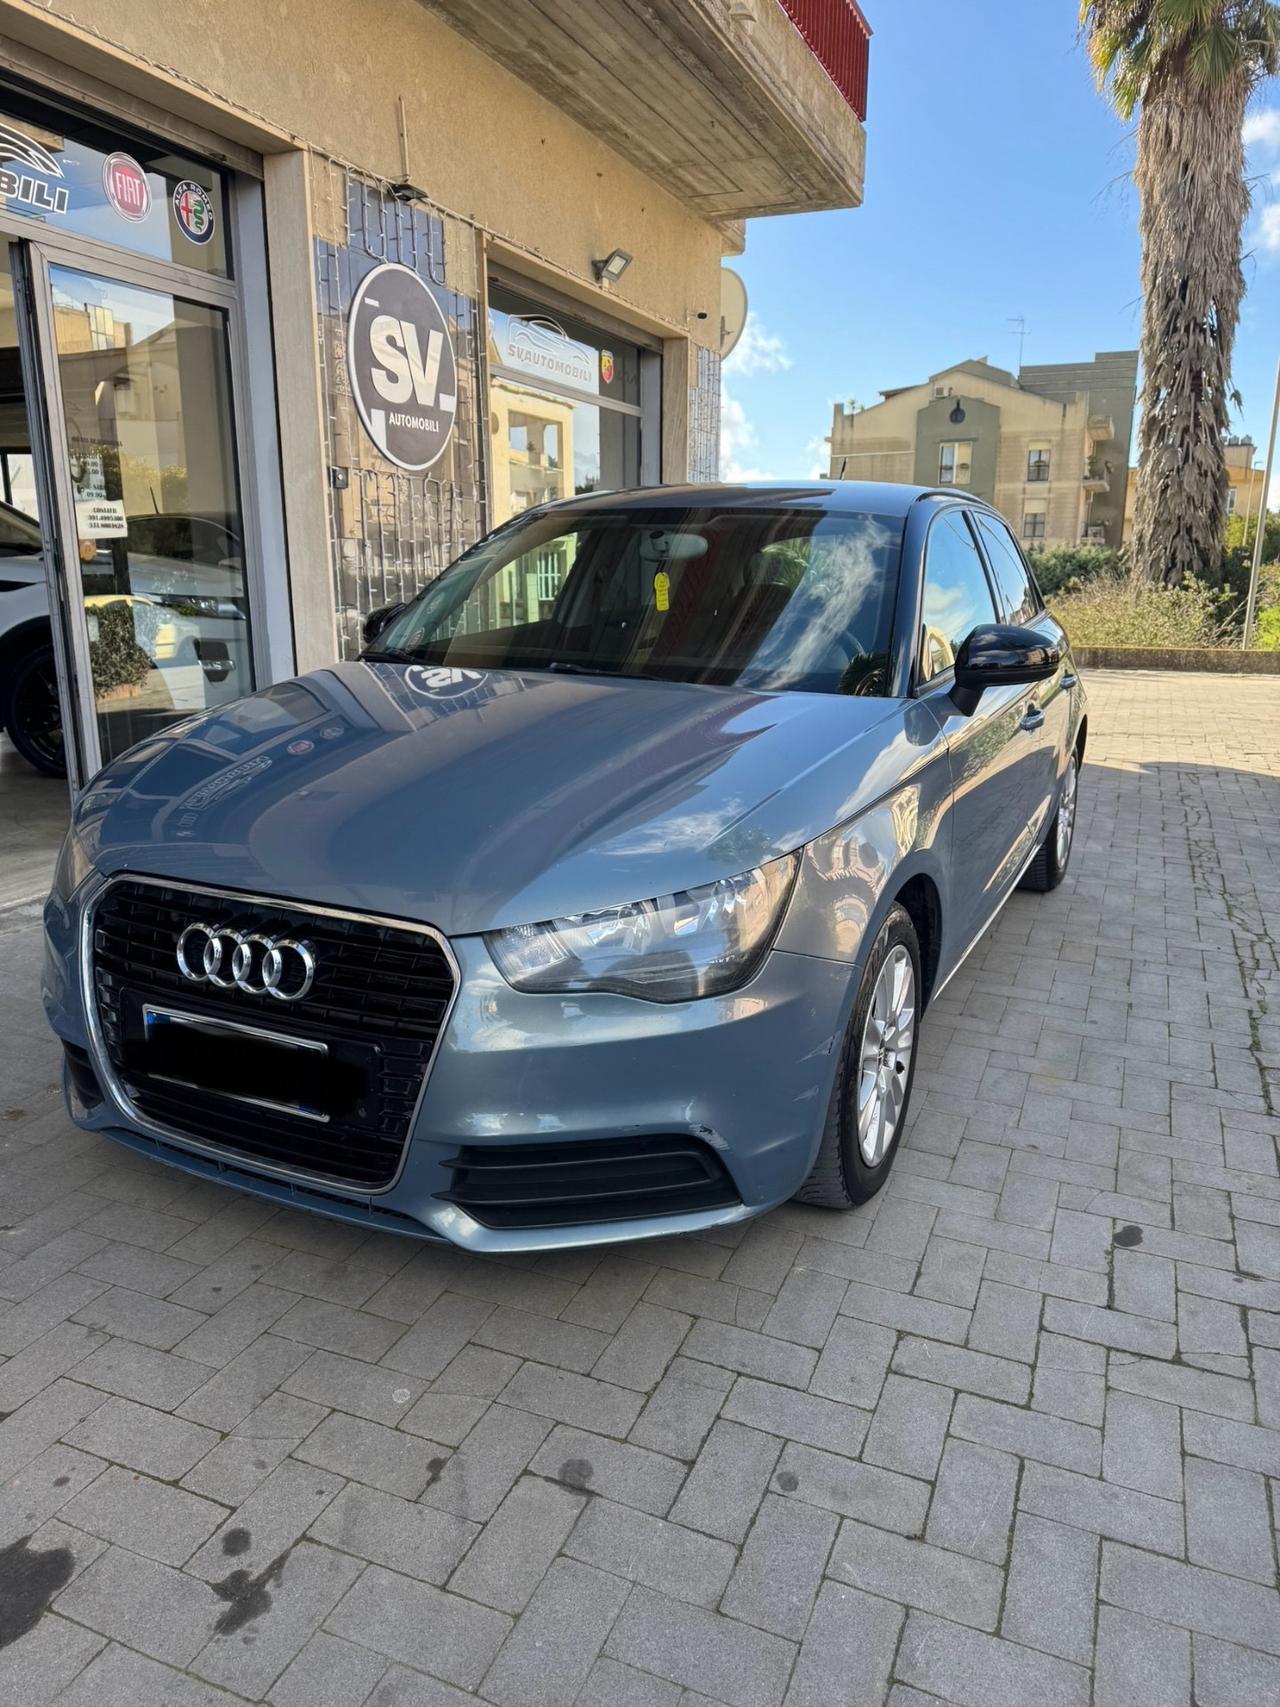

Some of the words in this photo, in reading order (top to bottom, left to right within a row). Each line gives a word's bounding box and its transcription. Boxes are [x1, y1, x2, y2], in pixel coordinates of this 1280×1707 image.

[115, 171, 141, 207] FIAT
[175, 184, 188, 207] ALFA
[190, 184, 213, 220] ROMEO
[370, 314, 444, 407] SV
[389, 412, 439, 433] AUTOMOBILI
